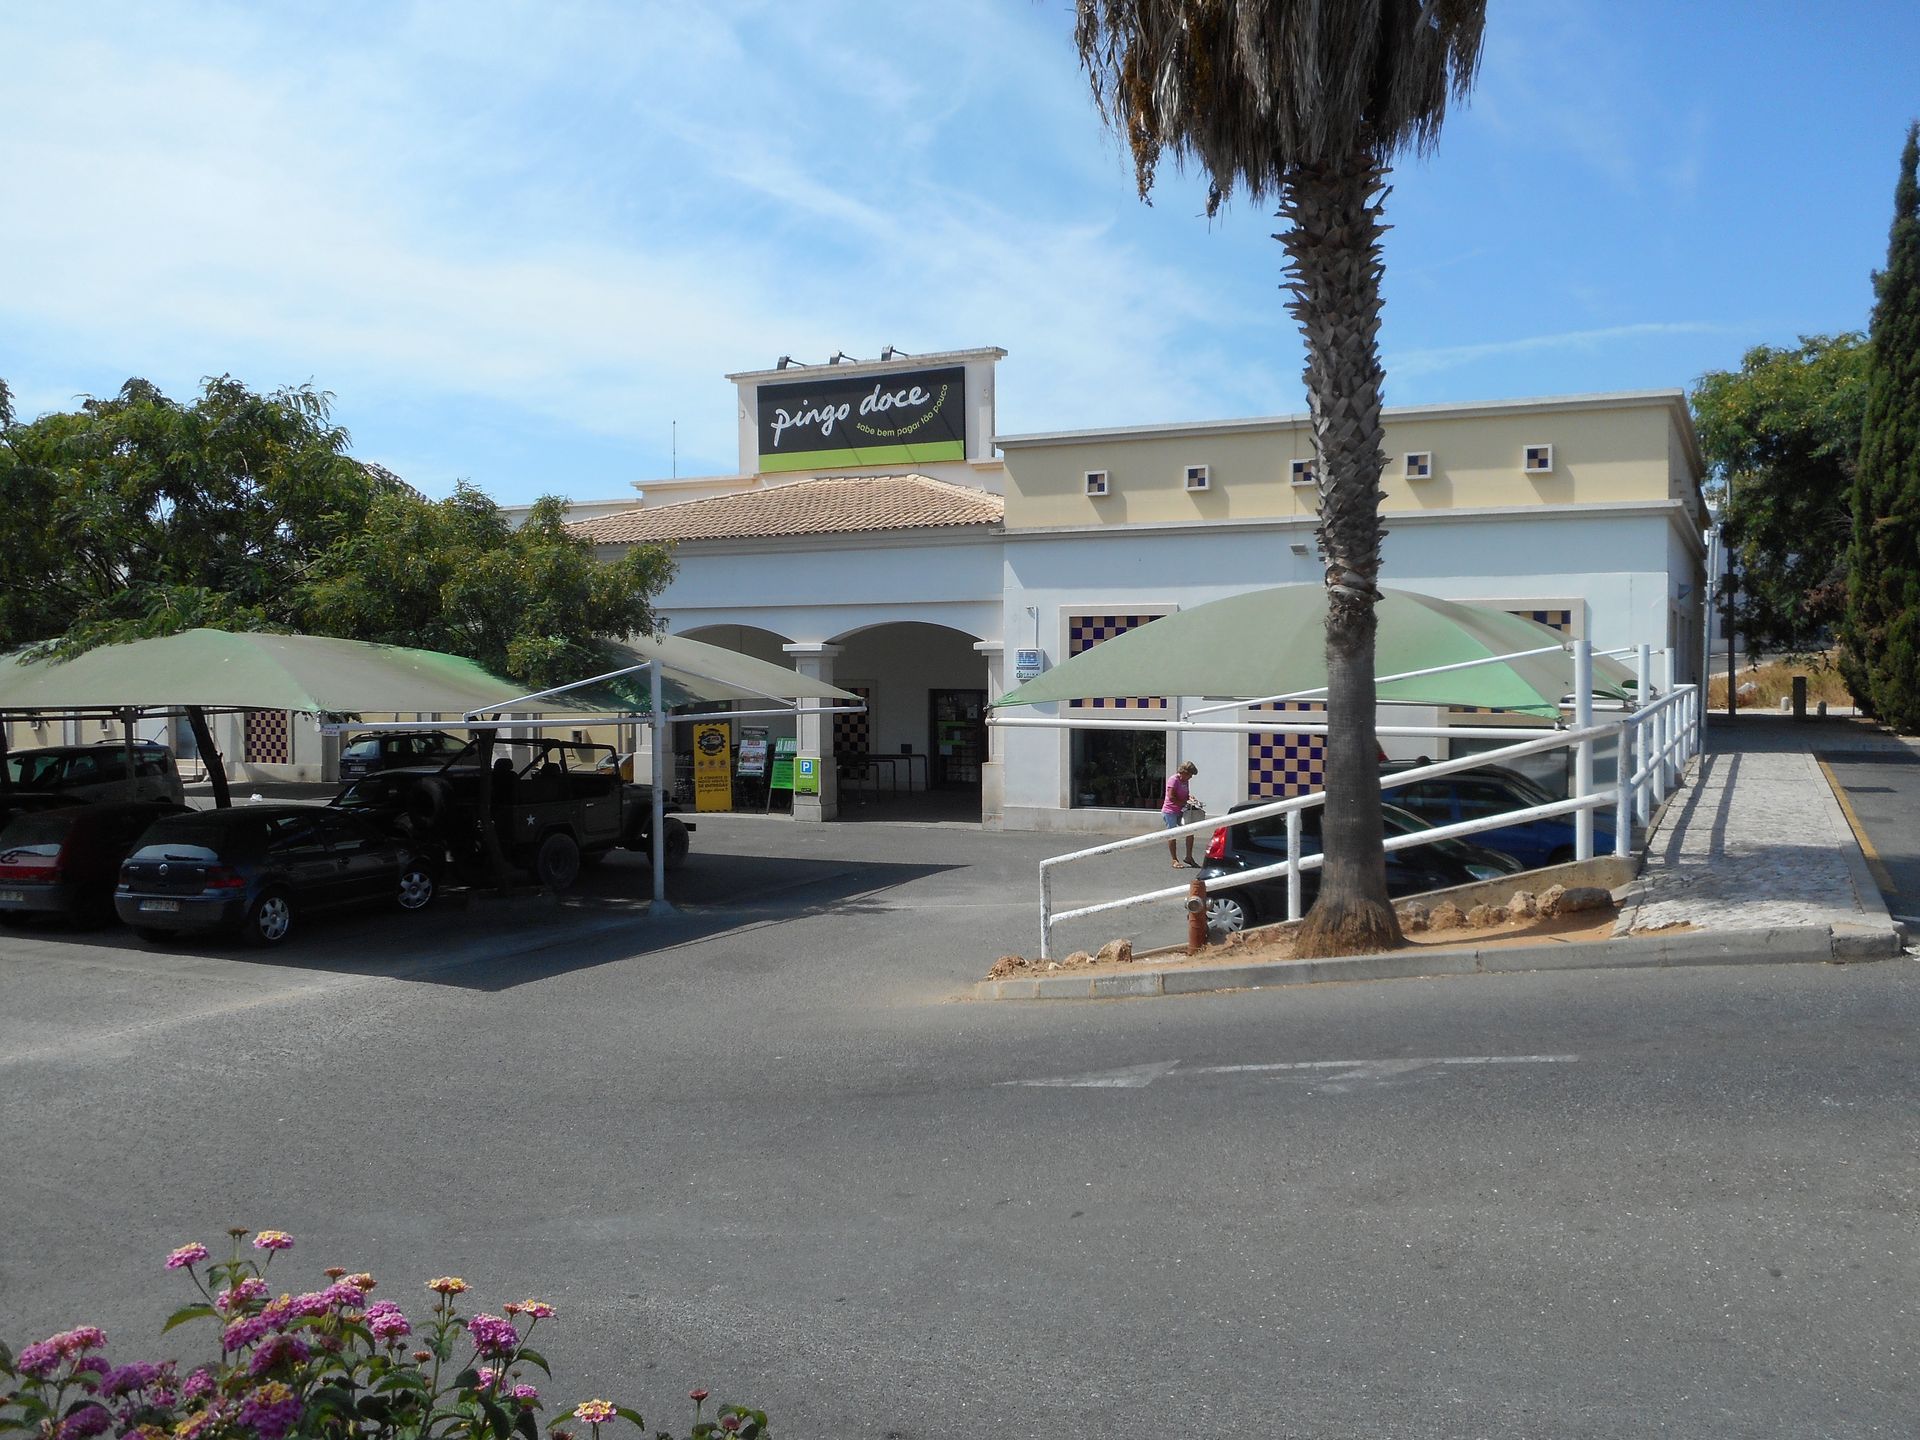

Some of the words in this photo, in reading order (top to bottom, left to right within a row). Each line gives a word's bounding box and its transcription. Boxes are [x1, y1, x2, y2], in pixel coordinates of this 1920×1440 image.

[771, 399, 850, 447] pingo
[859, 383, 930, 416] doce
[856, 422, 875, 434] sabe
[877, 428, 895, 437] bem
[897, 421, 920, 437] pagar
[932, 384, 948, 413] pouco
[802, 762, 810, 772] P
